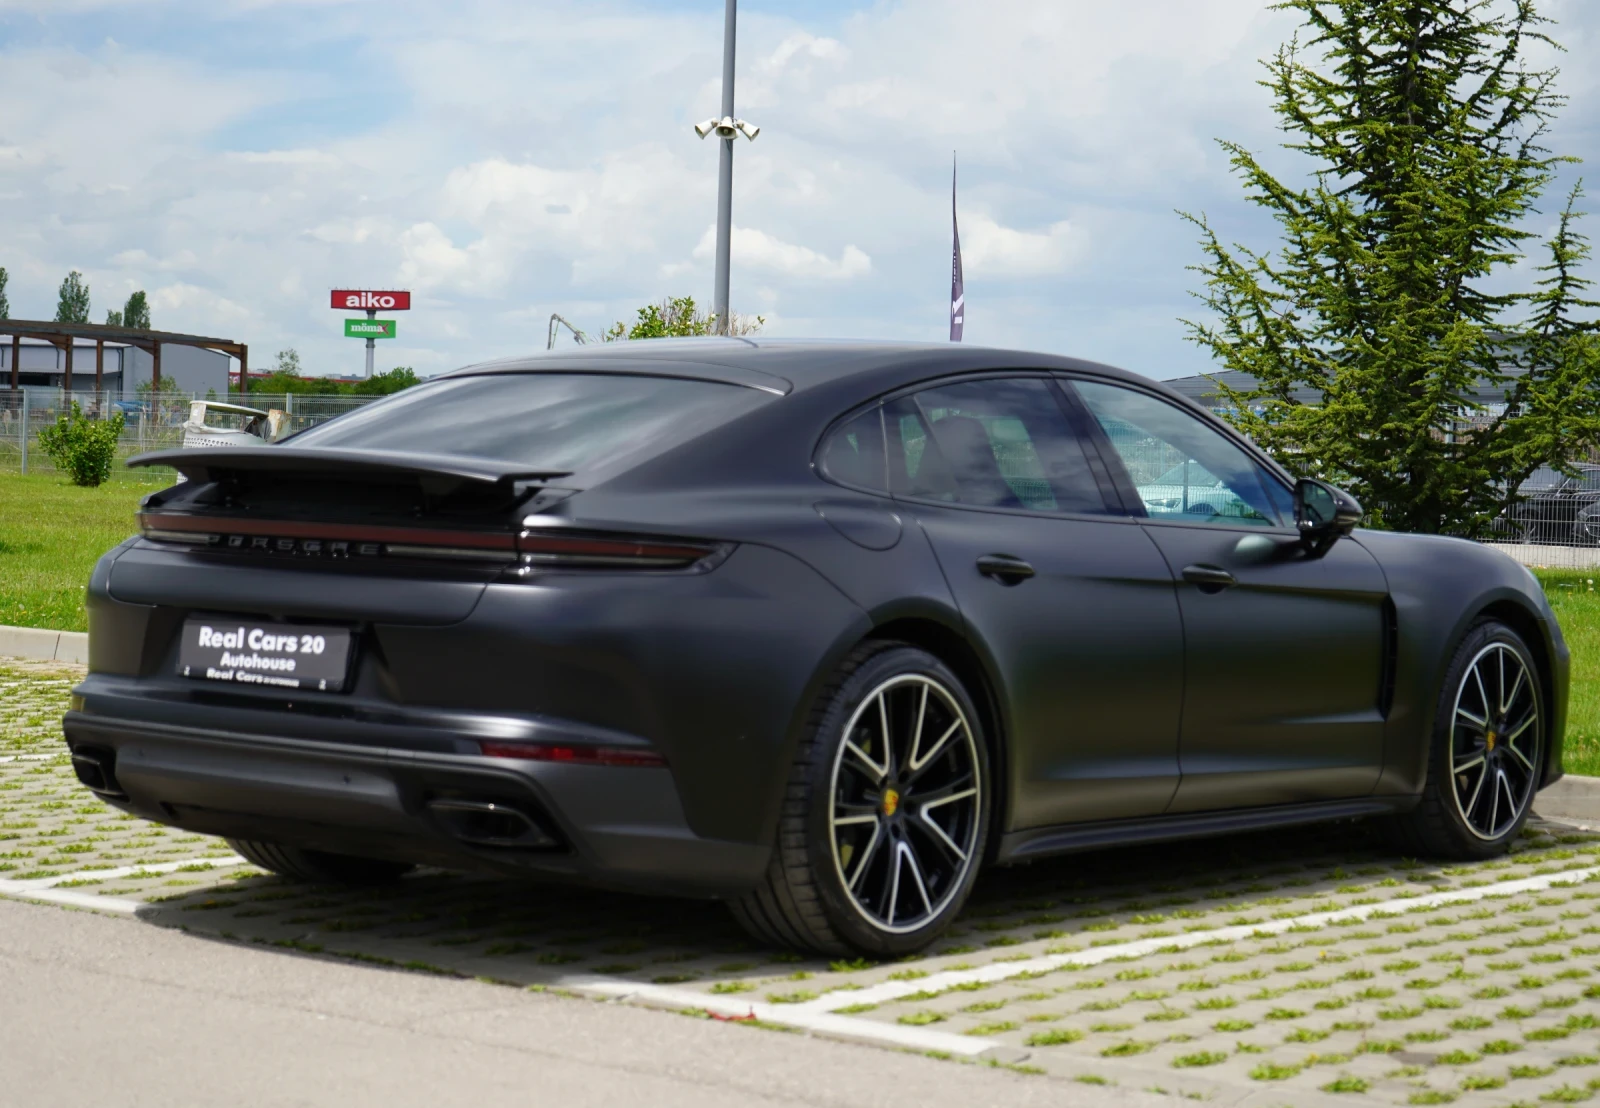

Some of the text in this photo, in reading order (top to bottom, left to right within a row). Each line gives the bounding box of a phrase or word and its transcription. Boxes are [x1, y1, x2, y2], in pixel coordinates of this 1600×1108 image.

[346, 292, 395, 308] aiko
[350, 322, 390, 335] mömax
[199, 625, 325, 654] Real Cars 20
[220, 651, 296, 671] Autohouse
[206, 667, 233, 680] Real
[236, 671, 263, 684] Cars
